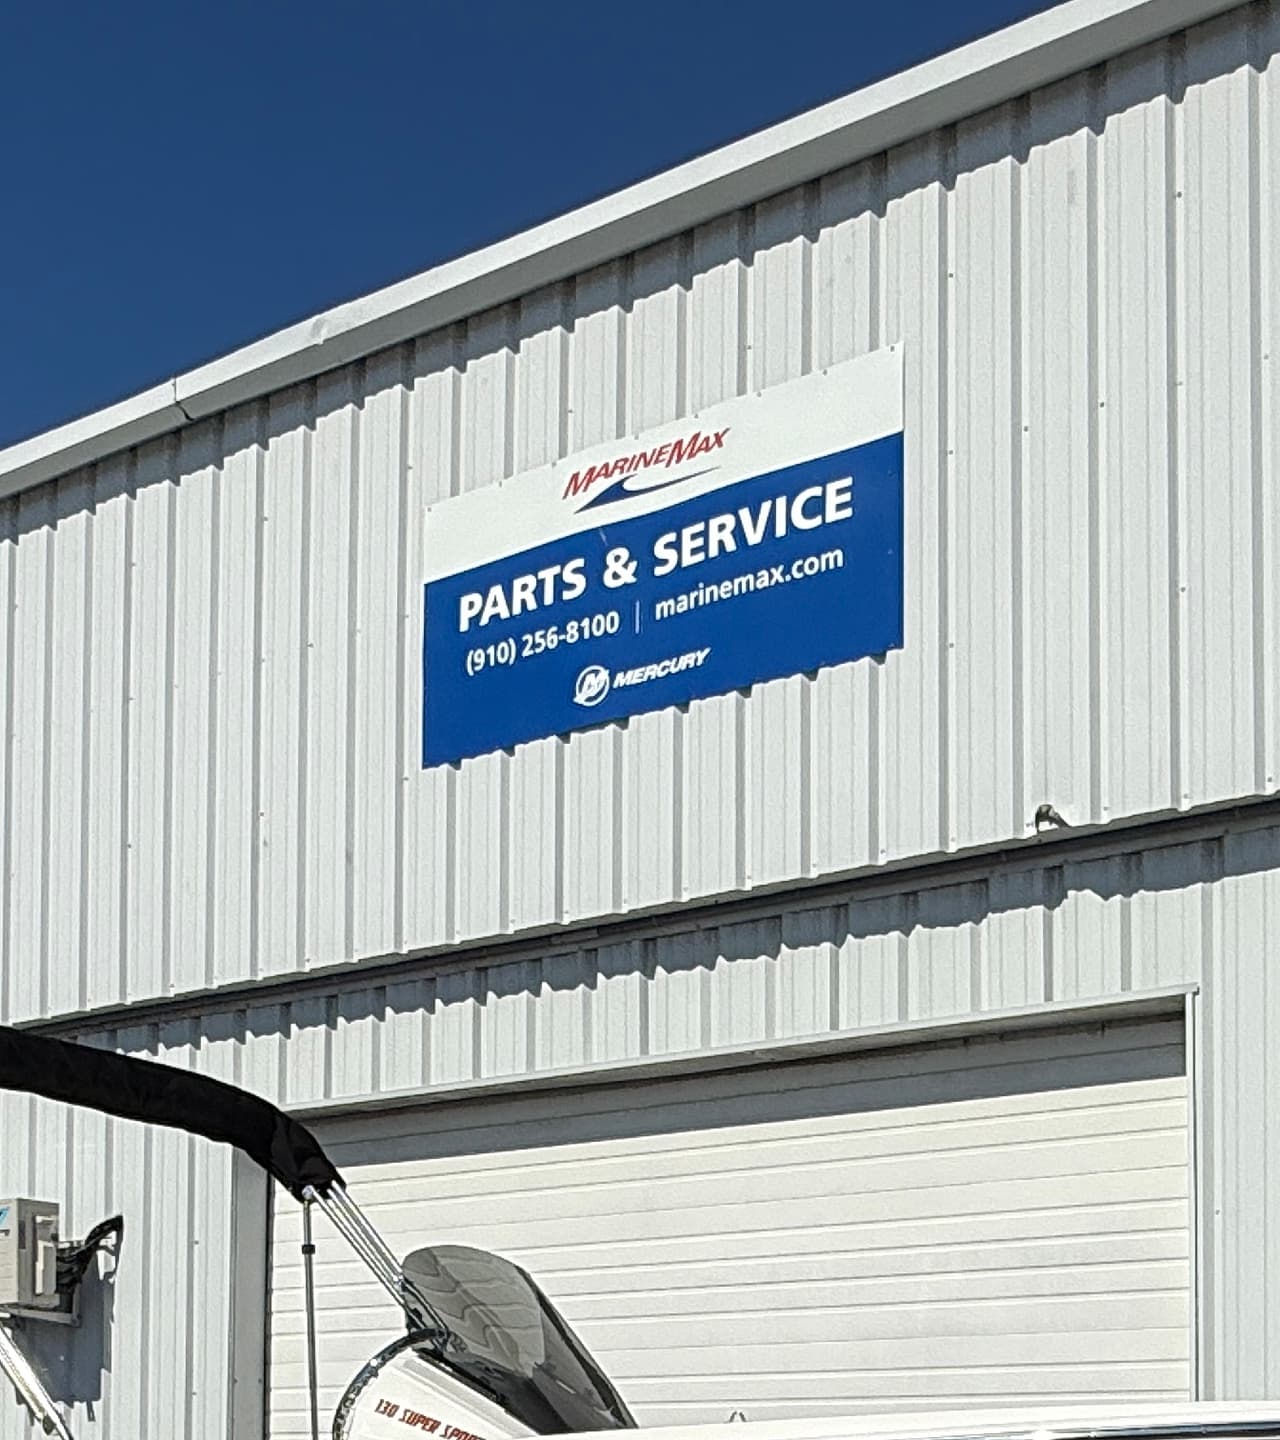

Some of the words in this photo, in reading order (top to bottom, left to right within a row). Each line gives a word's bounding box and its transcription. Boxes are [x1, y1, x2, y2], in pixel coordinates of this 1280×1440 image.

[459, 558, 586, 632] PARTS
[603, 547, 637, 588] &
[654, 476, 853, 576] SERVICE
[466, 637, 516, 676] (910)
[521, 611, 620, 658] 256-8100
[655, 548, 844, 620] marinemax.com
[613, 647, 711, 689] MERCURY
[374, 1398, 400, 1418] 130
[398, 1409, 441, 1434] SUPER
